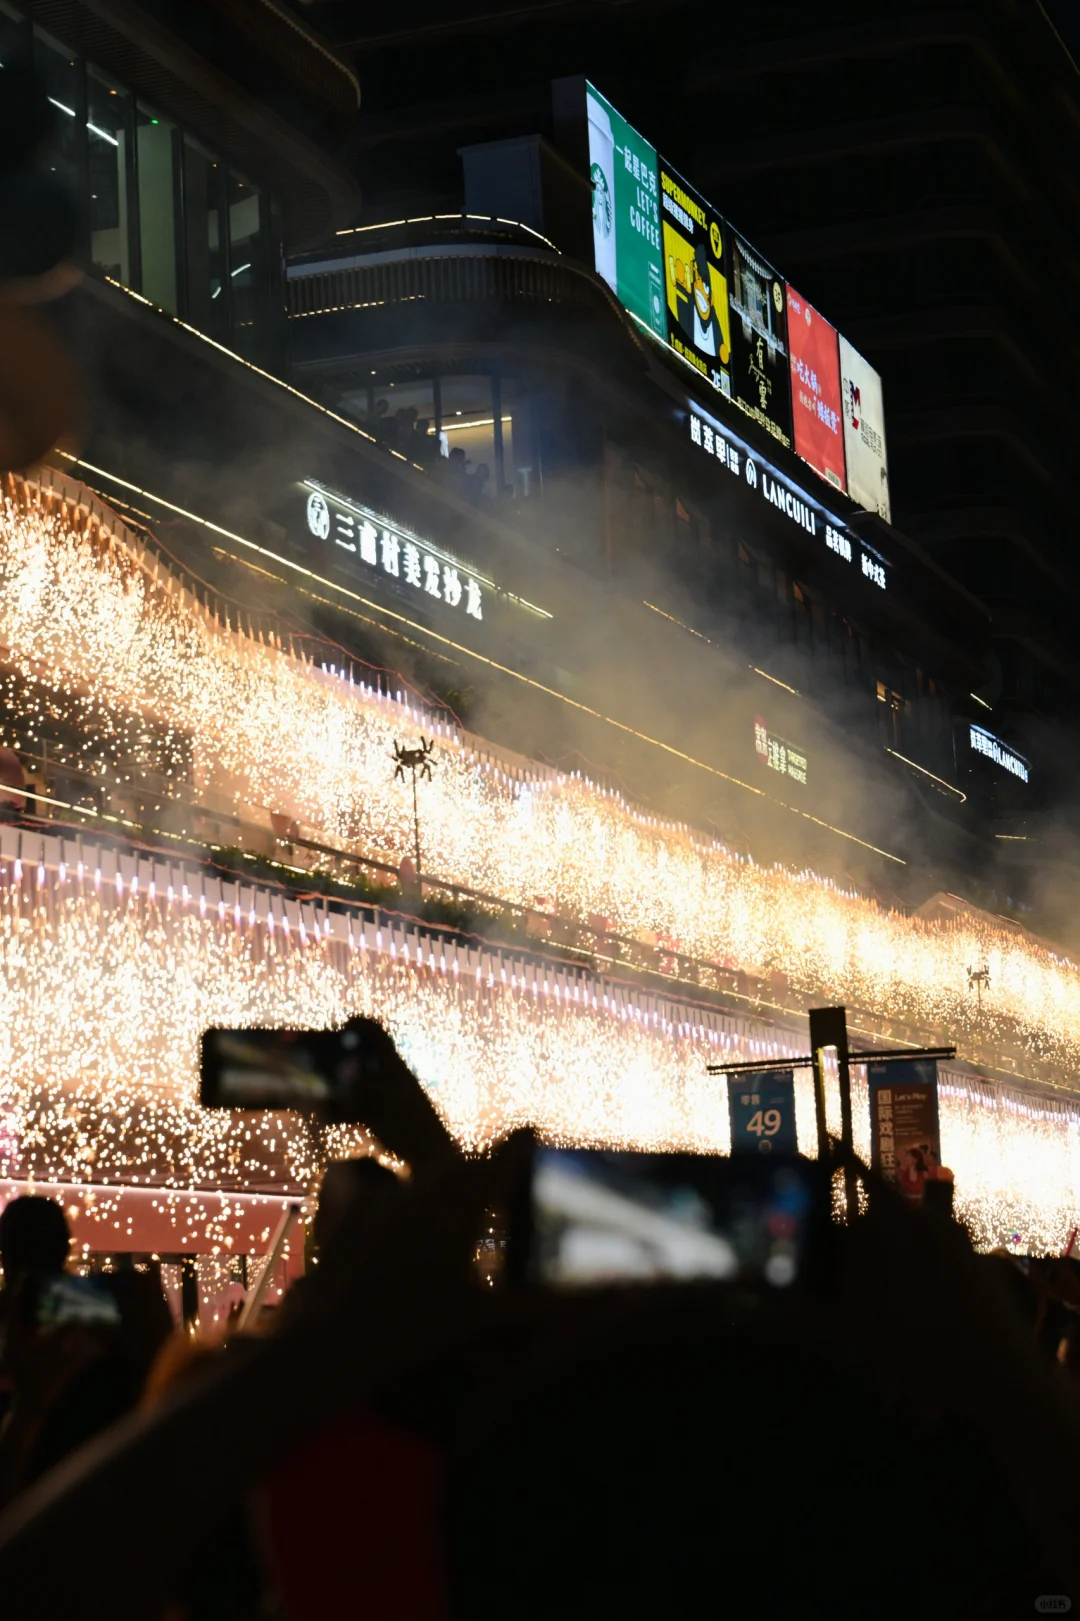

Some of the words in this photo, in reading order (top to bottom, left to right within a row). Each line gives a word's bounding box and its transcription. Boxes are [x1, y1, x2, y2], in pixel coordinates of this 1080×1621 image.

[615, 145, 656, 197] 一起星巴克
[630, 205, 660, 250] COFFEE
[637, 186, 658, 224] LET'S
[762, 473, 816, 536] LANCUILI
[746, 1108, 781, 1136] 49
